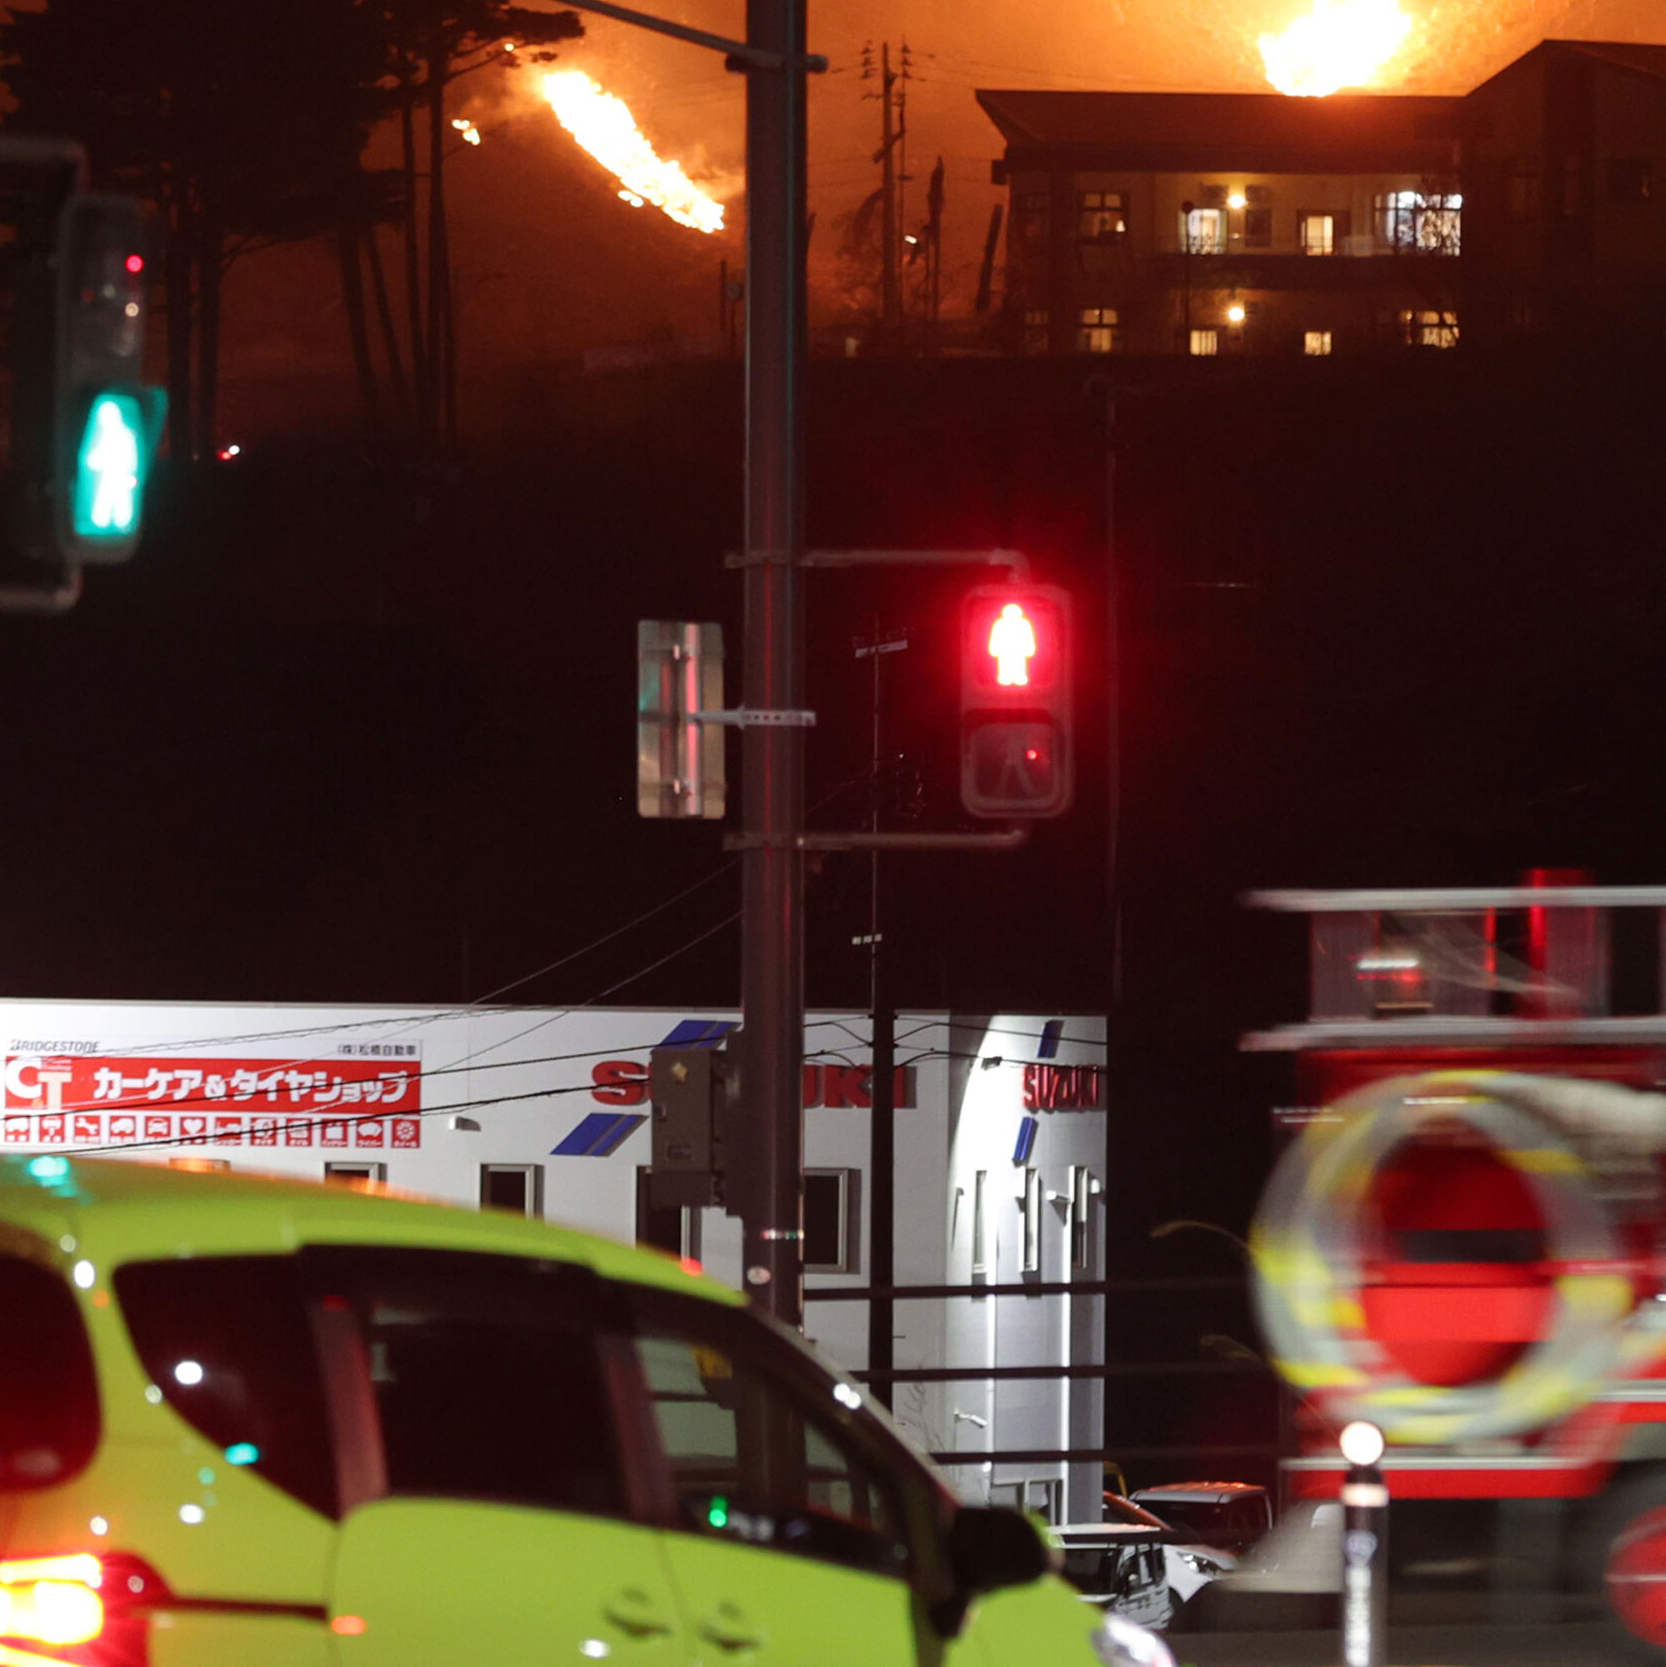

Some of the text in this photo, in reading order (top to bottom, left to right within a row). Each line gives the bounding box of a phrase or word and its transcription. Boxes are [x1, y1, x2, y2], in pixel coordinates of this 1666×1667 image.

[9, 1038, 101, 1054] BRIDGESTONE
[591, 1060, 906, 1109] SKI
[1022, 1064, 1101, 1110] SUZUKI
